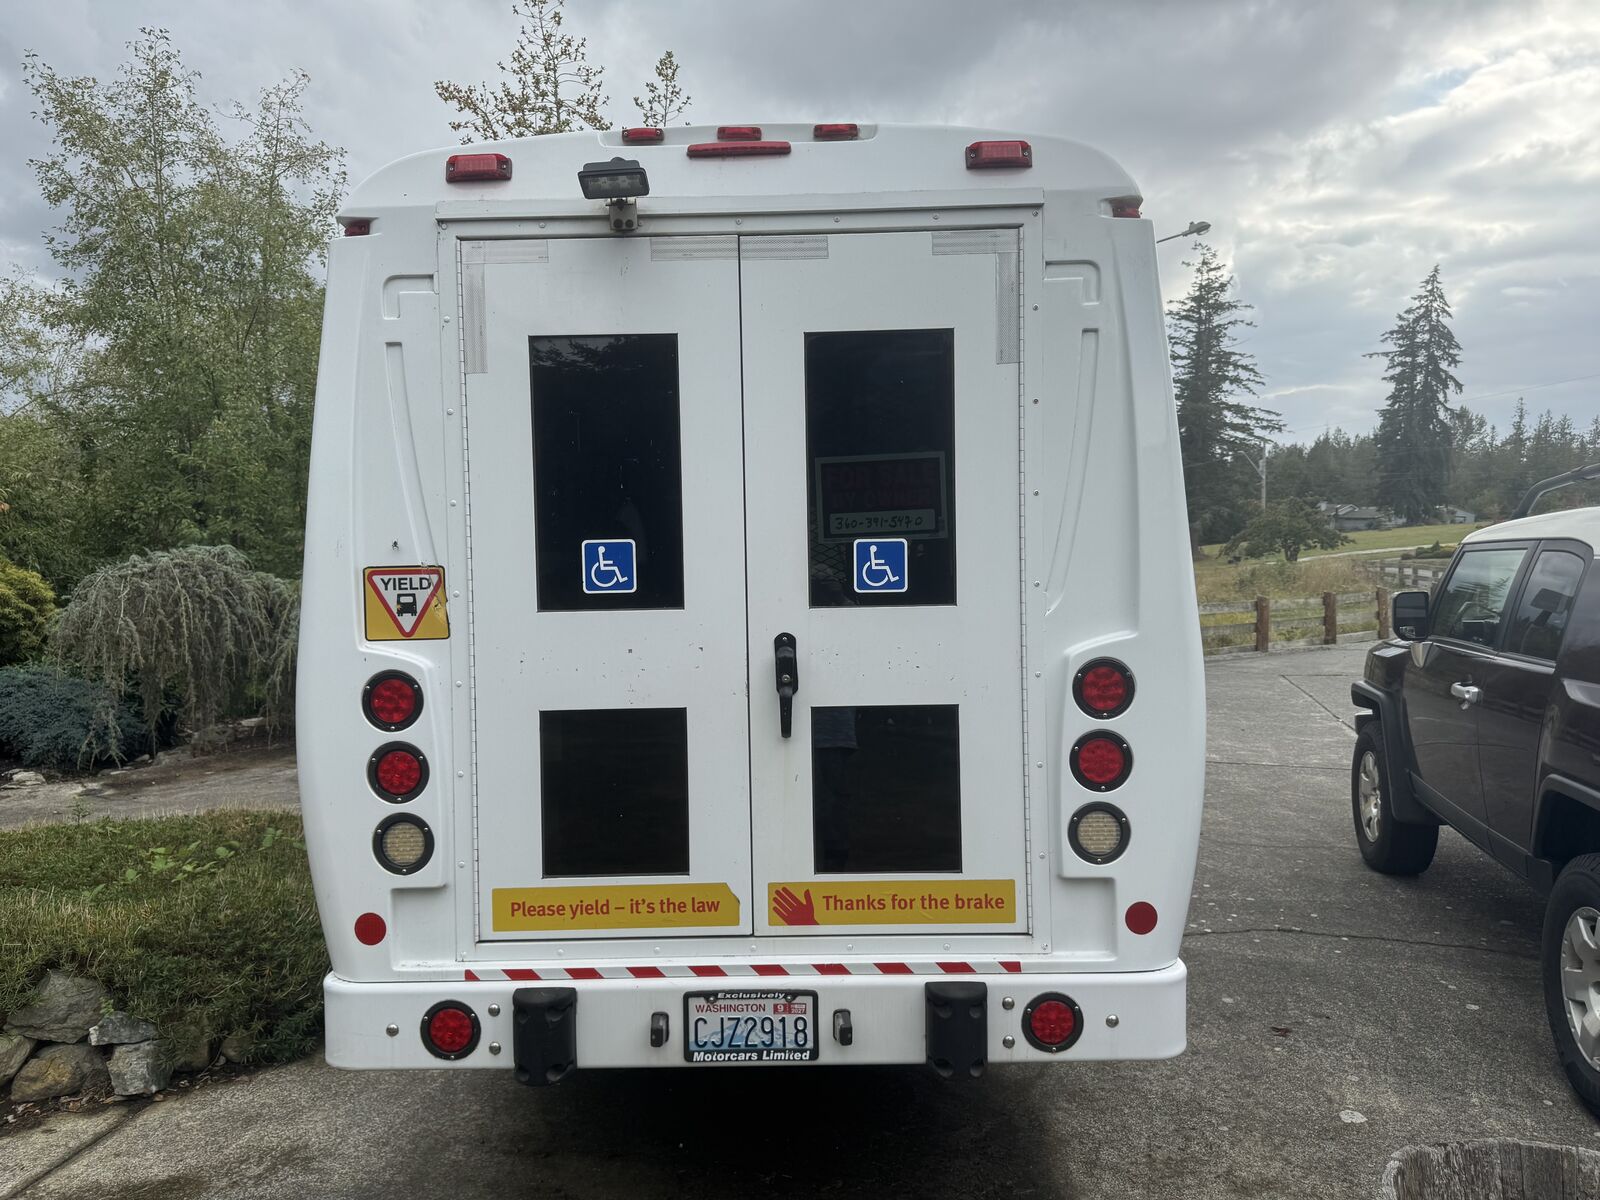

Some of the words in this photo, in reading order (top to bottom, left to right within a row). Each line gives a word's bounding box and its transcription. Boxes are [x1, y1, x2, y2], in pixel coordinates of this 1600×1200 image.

[380, 577, 432, 591] YIELD
[510, 901, 566, 918] Please
[569, 899, 610, 920] yield
[629, 897, 655, 915] it's
[659, 897, 687, 914] the
[691, 896, 720, 913] law
[822, 894, 886, 912] Thanks
[891, 893, 916, 911] for
[920, 894, 950, 910] the
[955, 893, 1005, 910] brake
[717, 992, 786, 1000] Exclusively
[695, 1003, 766, 1013] WASHINGTON
[694, 1016, 808, 1048] CJZ2918
[693, 1051, 758, 1062] Motorcars
[762, 1050, 810, 1061] Limited
